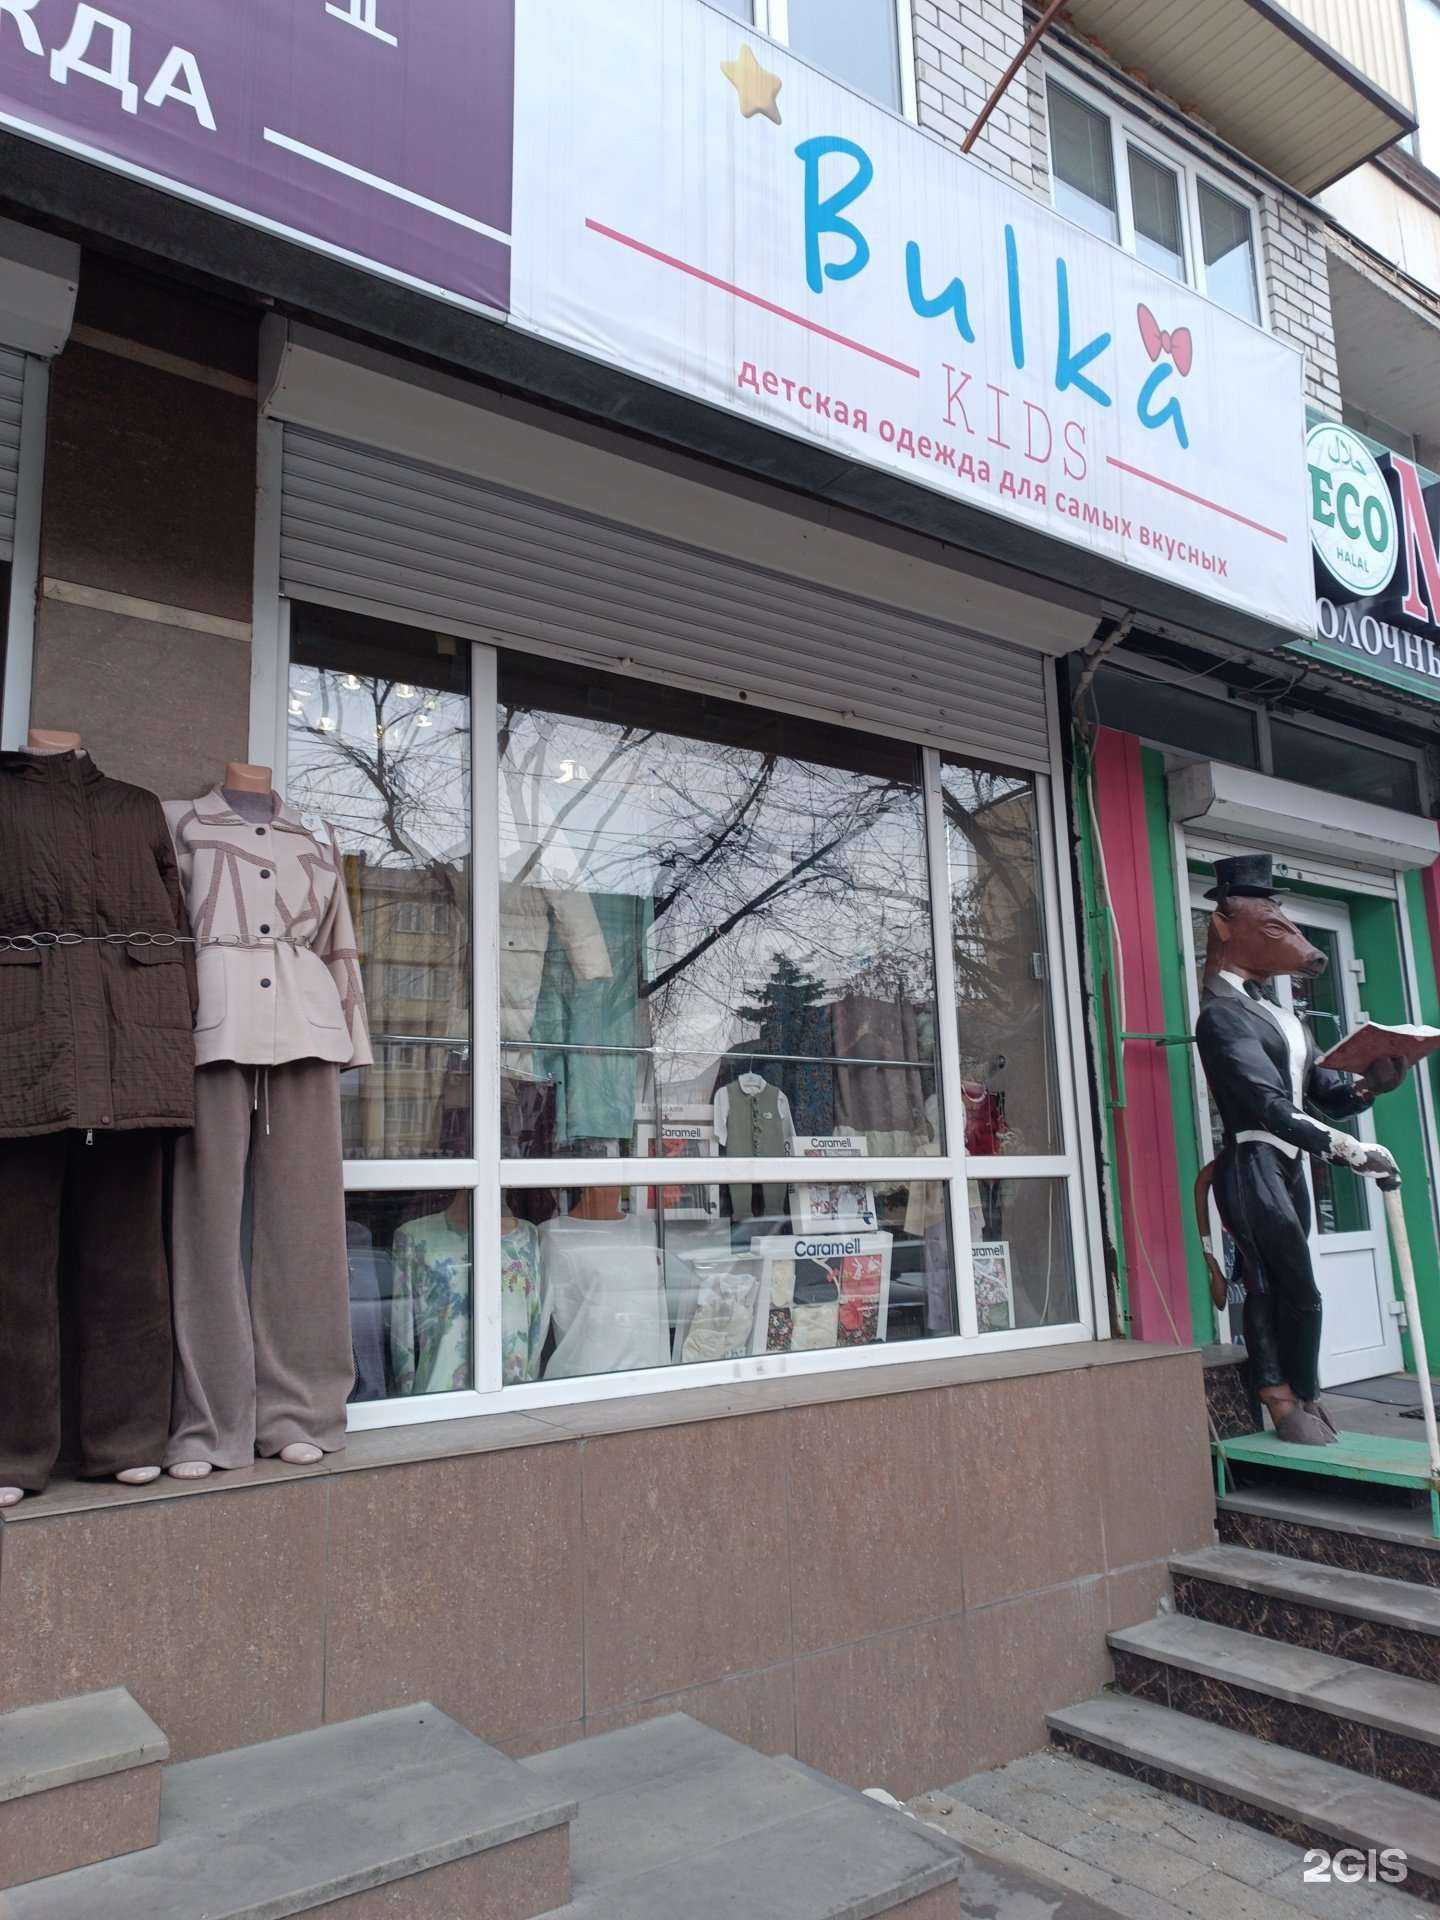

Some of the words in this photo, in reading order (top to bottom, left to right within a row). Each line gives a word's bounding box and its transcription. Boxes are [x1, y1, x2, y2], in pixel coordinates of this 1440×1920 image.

[794, 135, 1189, 449] Bulka
[942, 363, 1089, 482] KIDS
[738, 361, 869, 433] детская
[879, 419, 991, 484] одежда
[999, 470, 1047, 505] для
[1055, 492, 1132, 539] самых
[1139, 526, 1228, 577] вкусных
[1307, 463, 1389, 553] ECO
[1336, 546, 1369, 573] HALAL
[810, 1138, 852, 1148] Caramell
[794, 1238, 861, 1257] Caramell
[971, 1244, 1005, 1257] aramell
